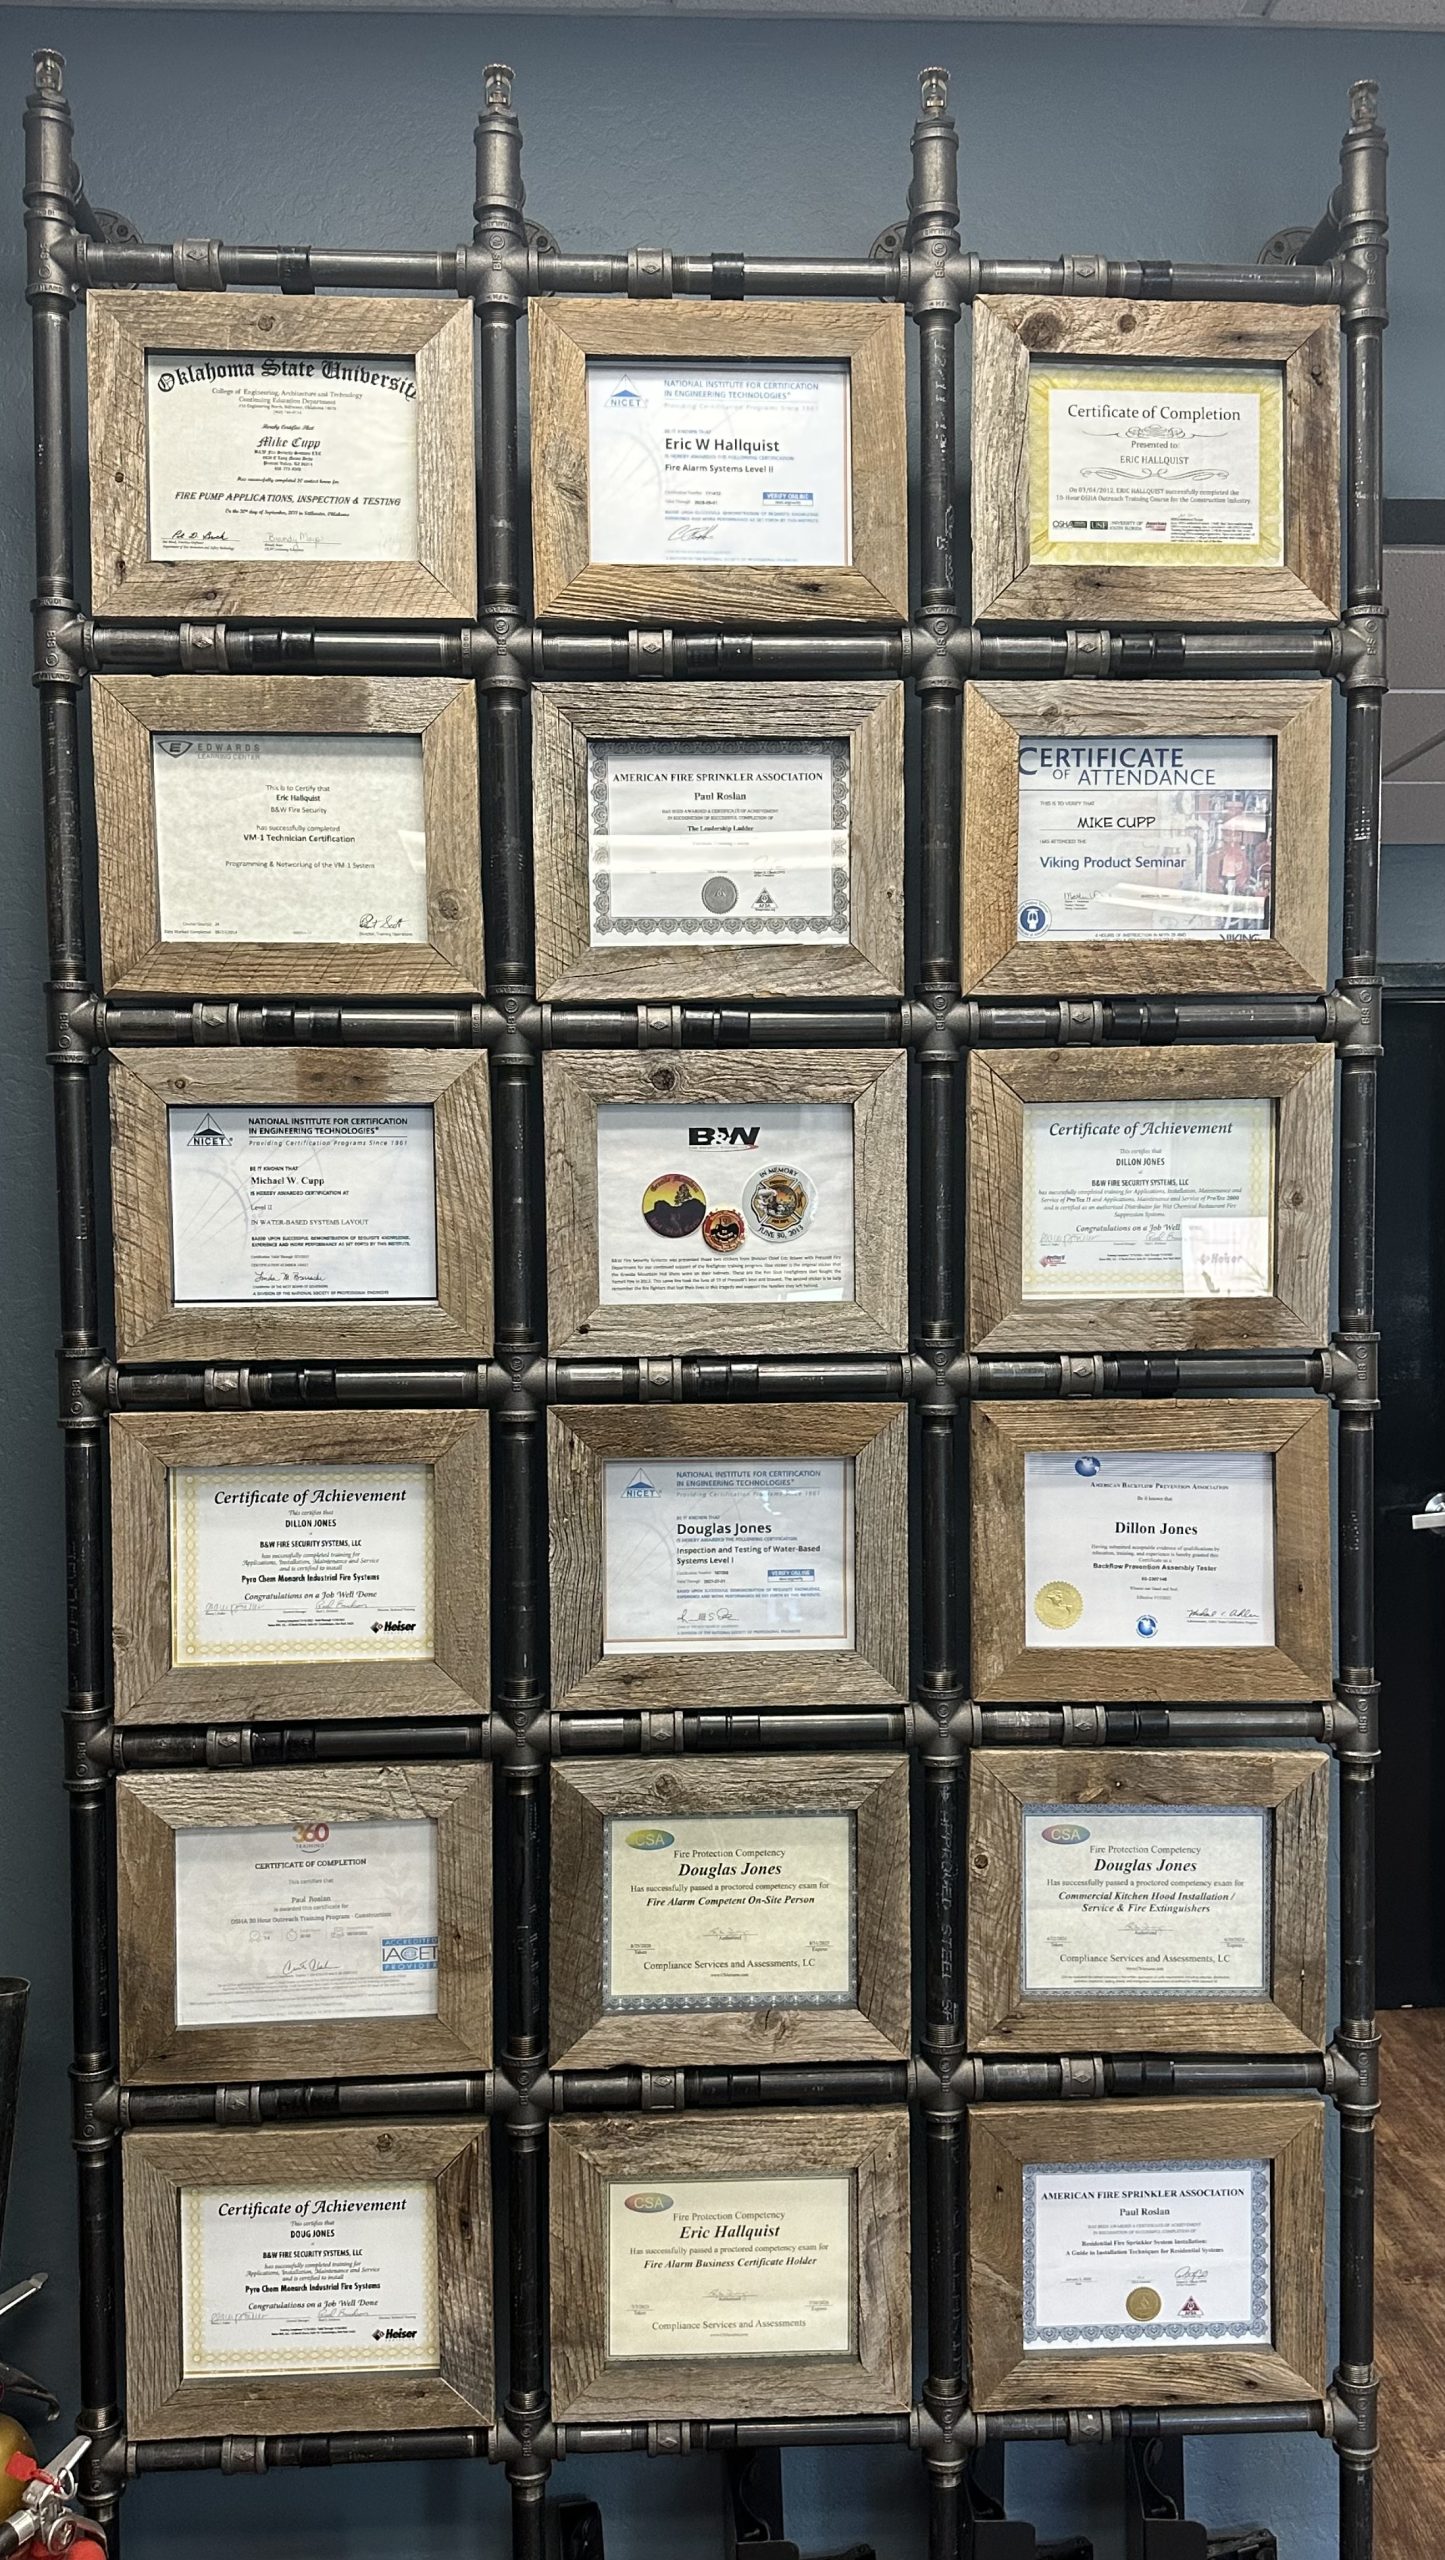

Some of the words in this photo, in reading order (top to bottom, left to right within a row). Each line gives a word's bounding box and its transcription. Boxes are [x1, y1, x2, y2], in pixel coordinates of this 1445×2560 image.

[157, 362, 254, 393] Oklahoma
[261, 359, 314, 377] State
[321, 360, 417, 402] University
[1068, 405, 1139, 419] Certificate
[1142, 406, 1157, 418] of
[1160, 407, 1241, 422] Completion
[257, 437, 287, 448] Mike
[292, 437, 320, 450] Cupp
[665, 438, 691, 450] Eric
[696, 439, 710, 450] W
[714, 438, 779, 454] Hallquist
[1131, 441, 1168, 449] Presented
[1120, 456, 1139, 464] ERIC
[1142, 456, 1189, 465] HALLQUIST
[710, 465, 743, 473] Systems
[175, 492, 196, 500] FIRE
[199, 492, 224, 500] PUMP
[226, 493, 294, 503] APPLICATIONS,
[297, 495, 350, 504] INSPECTION
[362, 497, 401, 505] TESTING
[198, 743, 260, 751] EDWARDS
[1018, 747, 1184, 775] CERTIFICATE
[613, 774, 668, 782] AMERICAN
[696, 773, 754, 781] SPRINKLER
[756, 772, 823, 781] ASSOCIATION
[1053, 769, 1070, 779] OF
[1078, 769, 1216, 785] ATTENDANCE
[717, 792, 746, 800] Roslan
[1078, 817, 1113, 828] MIKE
[1117, 817, 1156, 827] CUPP
[1040, 857, 1079, 870] Viking
[1084, 857, 1131, 868] Product
[1136, 858, 1186, 868] Seminar
[688, 1127, 760, 1145] B&W
[1049, 1122, 1120, 1139] Certificate
[1124, 1122, 1141, 1137] of
[1141, 1122, 1233, 1135] Achievement
[1116, 1158, 1141, 1166] DILLON
[1143, 1158, 1165, 1166] JONES
[760, 1170, 767, 1178] IN
[768, 1167, 799, 1177] MEMORY
[251, 1177, 284, 1185] Michael
[301, 1177, 325, 1186] Cupp
[758, 1226, 775, 1239] JUNE
[789, 1224, 804, 1237] 2013
[214, 1490, 289, 1507] Certificate
[293, 1489, 309, 1506] of
[311, 1489, 406, 1503] Achievement
[286, 1519, 312, 1528] DILLON
[314, 1519, 336, 1527] JONES
[1115, 1522, 1155, 1534] Dillon
[1160, 1523, 1198, 1535] Jones
[677, 1524, 731, 1537] Douglas
[734, 1523, 772, 1535] Jones
[260, 1540, 274, 1548] B&W
[677, 1546, 716, 1555] Inspection
[735, 1546, 761, 1554] Testing
[677, 1557, 708, 1565] Systems
[1162, 1564, 1195, 1572] Assembly
[384, 1621, 416, 1632] Heiser
[292, 1823, 330, 1843] 360
[1051, 1829, 1081, 1840] CSA
[635, 1835, 664, 1845] CSA
[674, 1850, 690, 1858] Fire
[736, 1849, 785, 1858] Competency
[255, 1861, 304, 1870] CERTIFICATE
[306, 1860, 315, 1868] OF
[317, 1858, 367, 1868] COMPLETION
[1094, 1859, 1152, 1874] Douglas
[1156, 1859, 1197, 1872] Jones
[678, 1864, 737, 1879] Douglas
[741, 1863, 781, 1875] Jones
[647, 1898, 665, 1906] Fire
[698, 1897, 746, 1907] Competent
[748, 1896, 782, 1904] On-Site
[1059, 1892, 1112, 1900] Commercial
[1115, 1892, 1148, 1900] Kitchen
[1151, 1892, 1176, 1900] Hood
[1178, 1892, 1229, 1901] Installation
[1082, 1904, 1114, 1912] Service
[1128, 1904, 1147, 1912] Fire
[1149, 1904, 1210, 1914] Extinguishers
[382, 1946, 438, 1962] IACET
[644, 1961, 692, 1970] Compliance
[694, 1960, 728, 1968] Services
[731, 1960, 745, 1968] and
[747, 1959, 800, 1968] Assessments,
[1042, 2191, 1095, 2200] AMERICAN
[1097, 2190, 1120, 2199] FIRE
[1122, 2190, 1177, 2198] SPRINKLER
[1179, 2189, 1244, 2197] ASSOCIATION
[634, 2197, 663, 2208] CSA
[218, 2202, 291, 2218] Certificate
[295, 2201, 310, 2217] of
[312, 2199, 407, 2213] Achievement
[1120, 2208, 1139, 2216] Paul
[290, 2230, 311, 2238] DOUG
[313, 2229, 335, 2237] JONES
[680, 2226, 711, 2239] Eric
[715, 2225, 780, 2240] Hallquist
[644, 2260, 663, 2269] Fire
[665, 2260, 693, 2268] Alarm
[696, 2259, 734, 2267] Business
[738, 2258, 784, 2268] Certificate
[786, 2257, 817, 2265] Holder
[385, 2329, 417, 2340] Heiser
